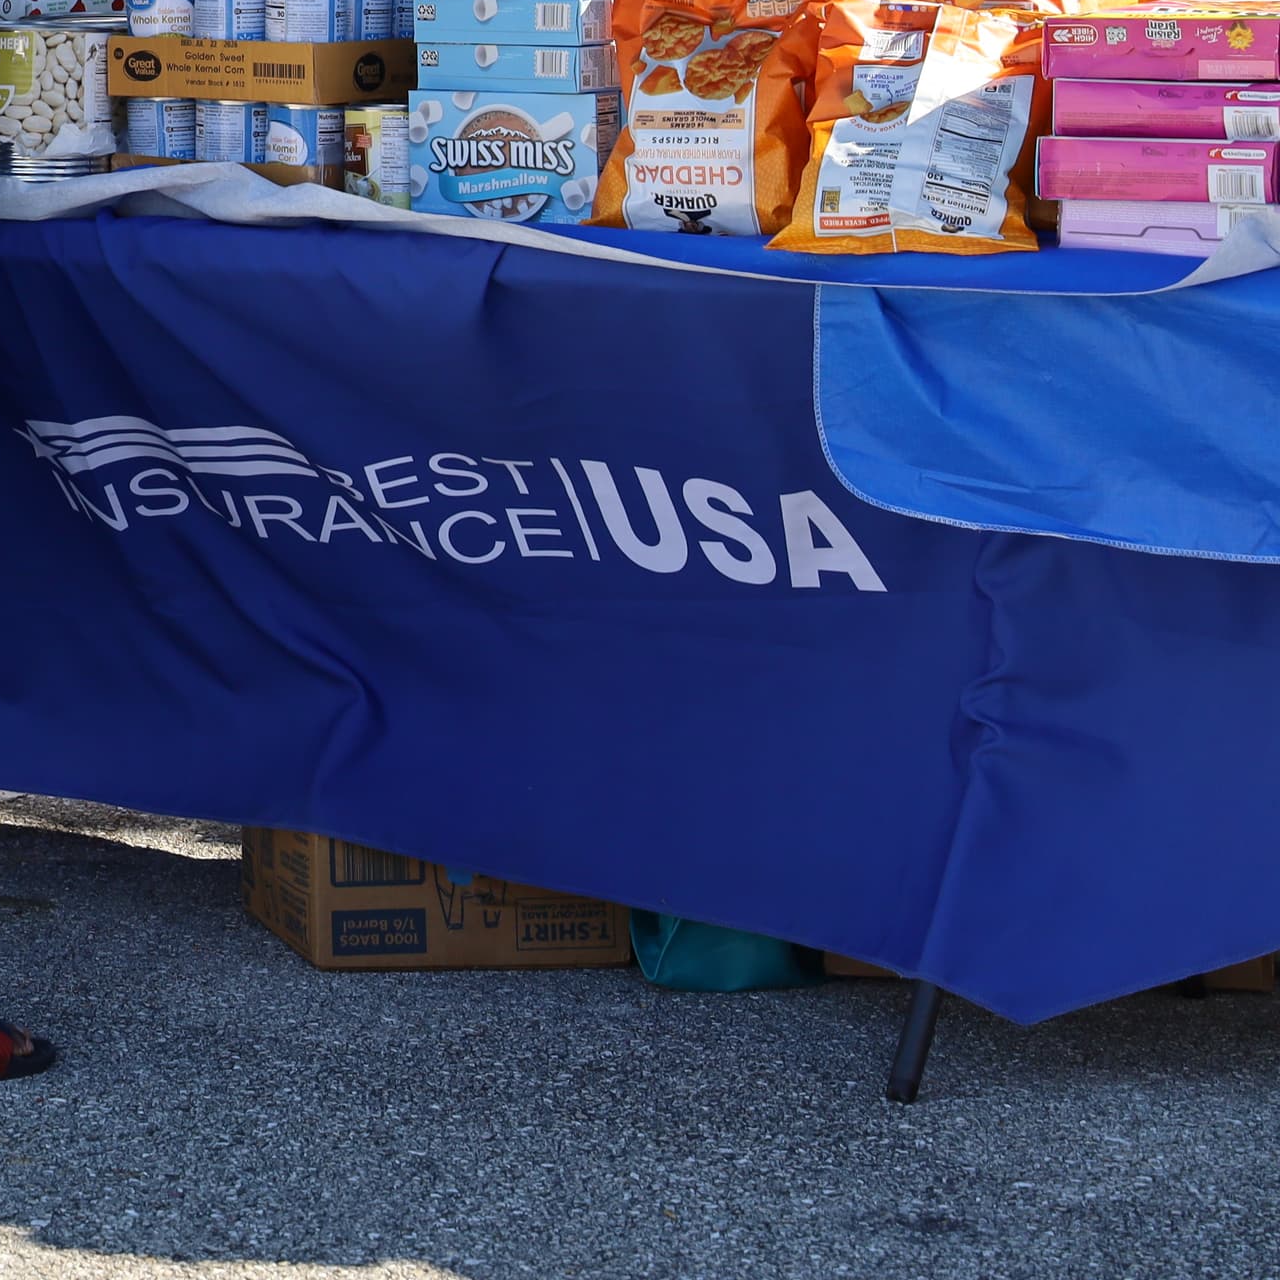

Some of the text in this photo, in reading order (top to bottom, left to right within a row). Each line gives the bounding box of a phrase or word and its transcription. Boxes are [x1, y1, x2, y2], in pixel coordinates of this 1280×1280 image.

[132, 14, 192, 25] Whole Kernel
[1149, 20, 1176, 31] Bran
[170, 24, 192, 32] Corn
[1071, 27, 1095, 35] FIBER
[1073, 34, 1095, 42] HIGH
[1145, 29, 1181, 40] Raisin
[128, 57, 156, 69] Great
[184, 51, 245, 63] Golden Sweet
[134, 66, 158, 76] Value
[166, 63, 245, 75] Whole Kernel Corn
[651, 136, 719, 145] RICE CRISPS
[272, 143, 298, 153] Kernel
[278, 153, 298, 162] Corn
[429, 136, 506, 173] SWISS
[717, 149, 741, 160] FLAVOR
[635, 165, 743, 186] CHEDDAR
[927, 172, 944, 181] 130
[458, 173, 548, 195] Marshmallow
[654, 193, 718, 210] QUAKER
[947, 199, 986, 214] Nutrition
[929, 207, 972, 226] QUAKER
[52, 467, 575, 564] INSURANCE
[579, 458, 888, 593] USA
[343, 917, 416, 932] 1/6 Barrel
[521, 922, 610, 942] T-SHIRT
[339, 933, 420, 947] 1000 BAGS
